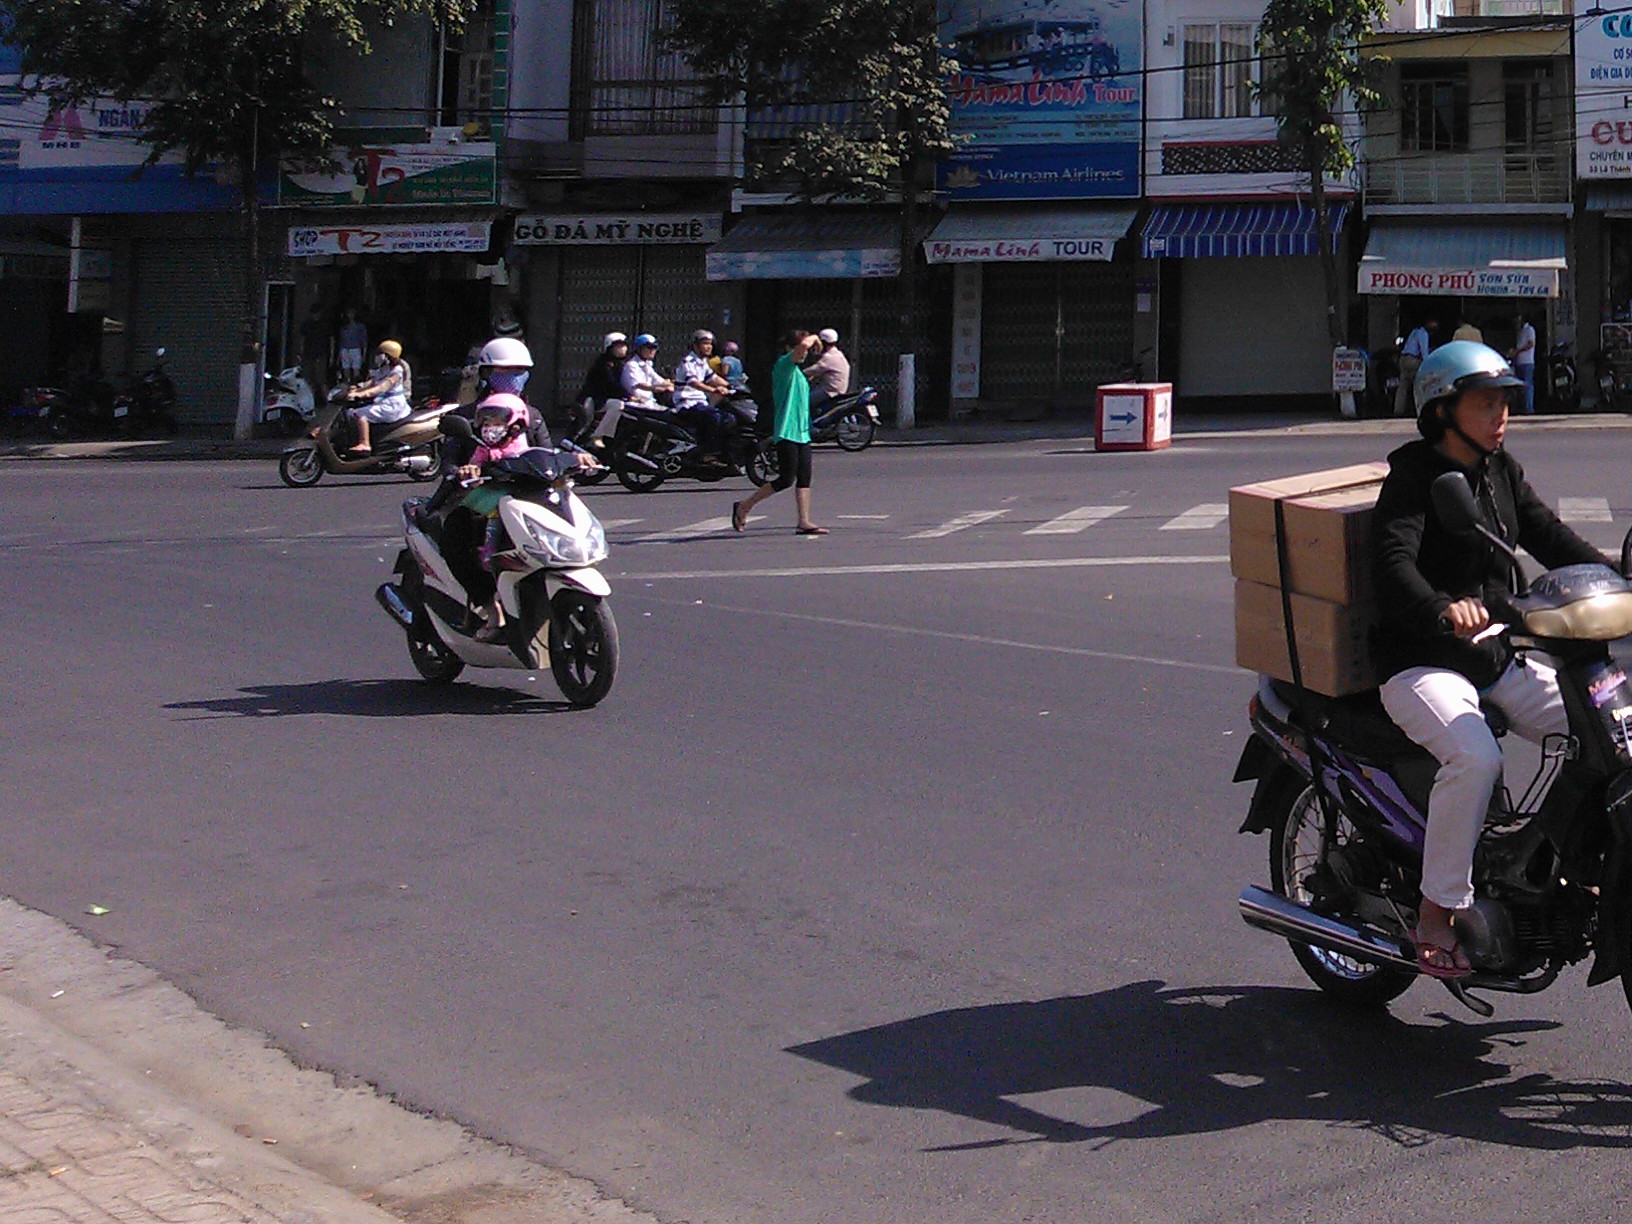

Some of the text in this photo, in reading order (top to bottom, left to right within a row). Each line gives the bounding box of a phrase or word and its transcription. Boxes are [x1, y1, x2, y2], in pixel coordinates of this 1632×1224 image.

[950, 75, 1024, 107] Mama
[1092, 84, 1136, 103] Tour
[986, 165, 1125, 182] Vietnam Airlines
[932, 241, 991, 257] Mama
[1053, 240, 1104, 255] TOUR
[1371, 270, 1476, 289] PHONG PHÚ
